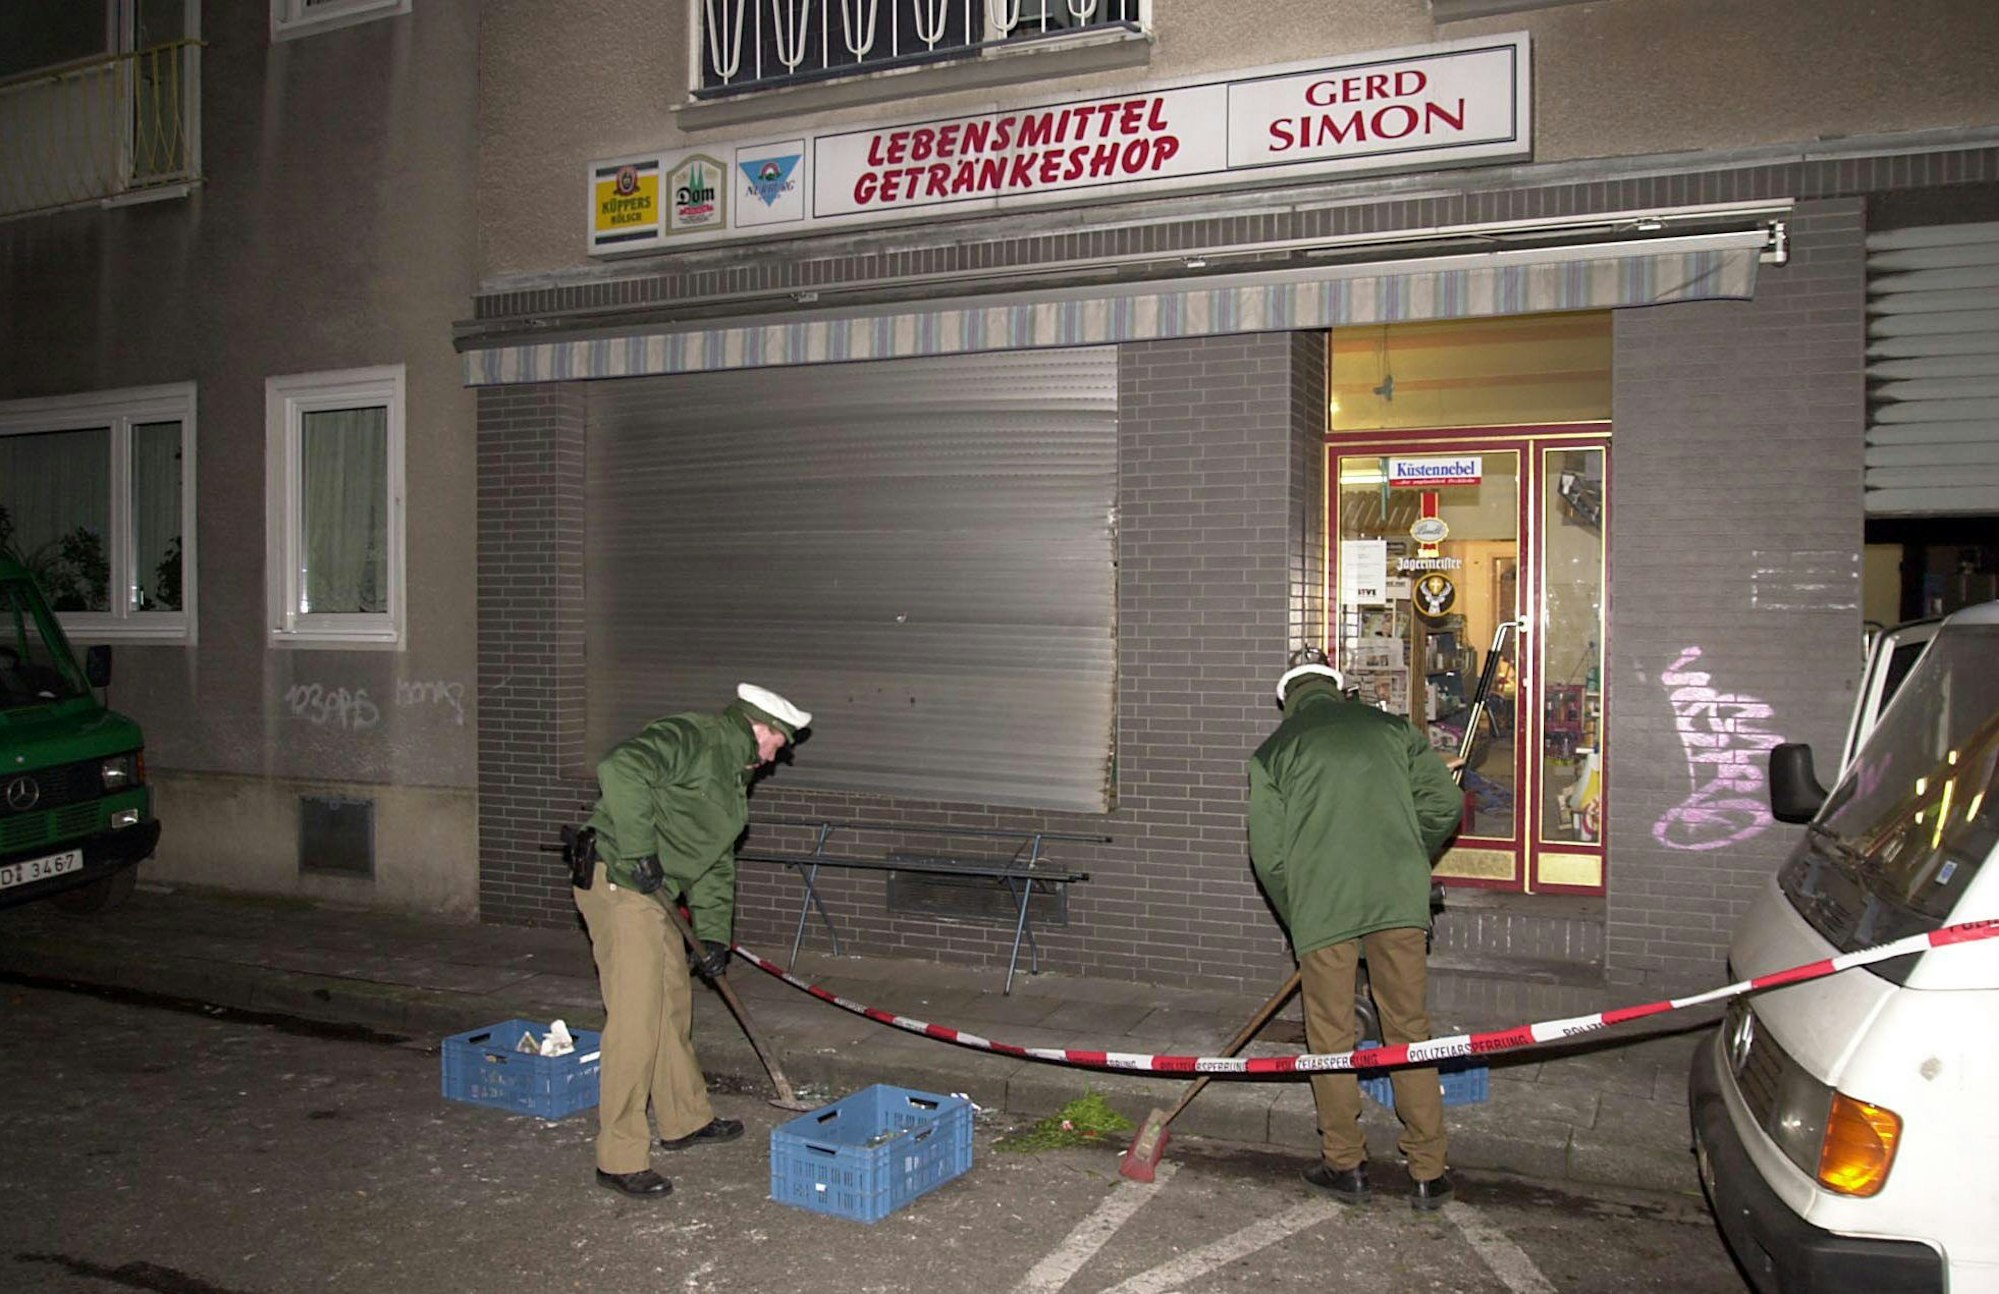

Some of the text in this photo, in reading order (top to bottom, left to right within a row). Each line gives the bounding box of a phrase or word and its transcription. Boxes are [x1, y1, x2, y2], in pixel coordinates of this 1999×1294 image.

[1304, 69, 1427, 106] GERD
[867, 98, 1168, 166] LEBENSMITTEL
[1268, 98, 1465, 151] SIMON
[854, 135, 1180, 205] GETRÄNKESHOP
[602, 196, 651, 214] KÜPPERS
[676, 186, 715, 206] Dom
[1397, 461, 1475, 477] Küstennebel
[32, 853, 75, 878] 3467
[1409, 1035, 1529, 1062] POLIZEIABSPERRUNG
